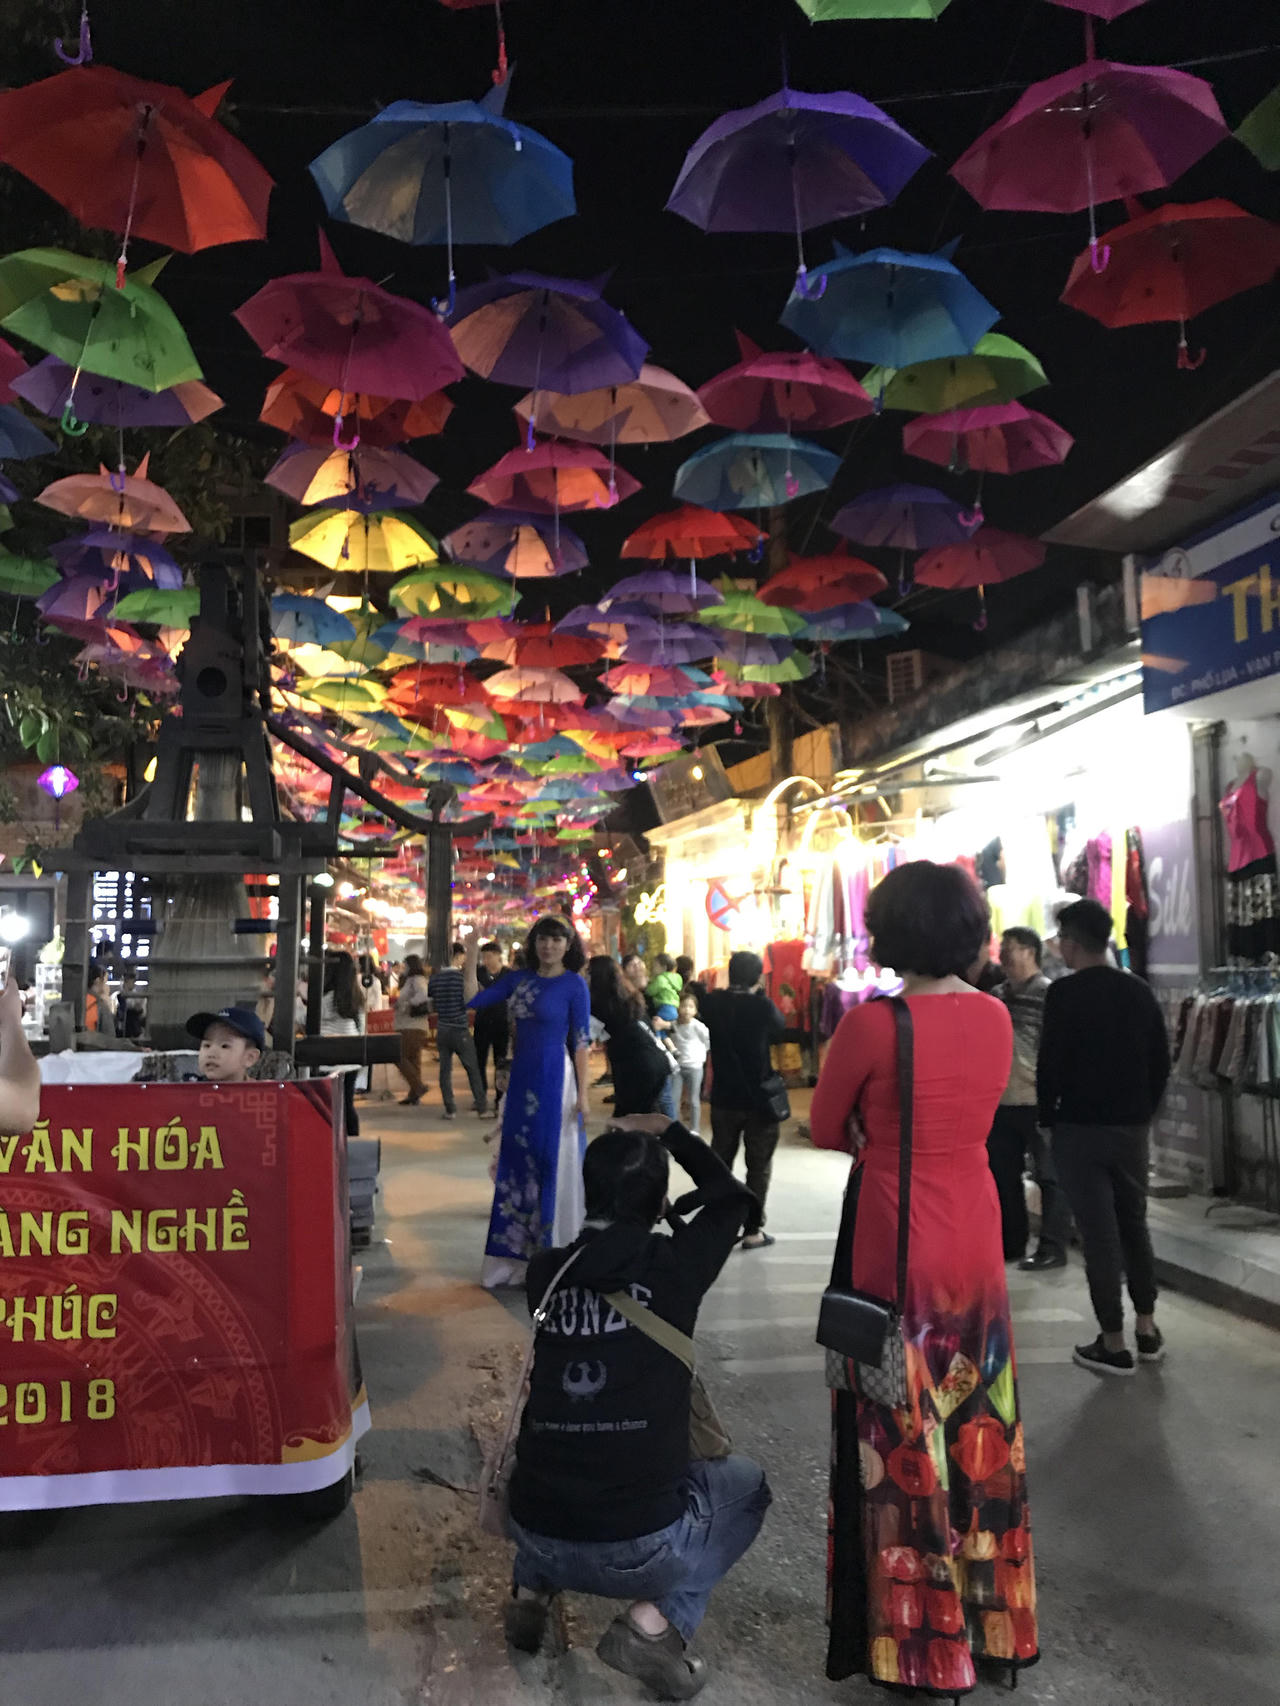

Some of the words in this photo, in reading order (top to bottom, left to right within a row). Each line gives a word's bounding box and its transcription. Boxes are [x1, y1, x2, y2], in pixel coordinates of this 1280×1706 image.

[1147, 856, 1191, 937] Silk
[0, 1119, 93, 1173] VĂN
[111, 1116, 225, 1171] HÓA
[110, 1188, 250, 1254] NGHỀ
[0, 1283, 118, 1342] HÚC
[0, 1378, 116, 1425] 018
